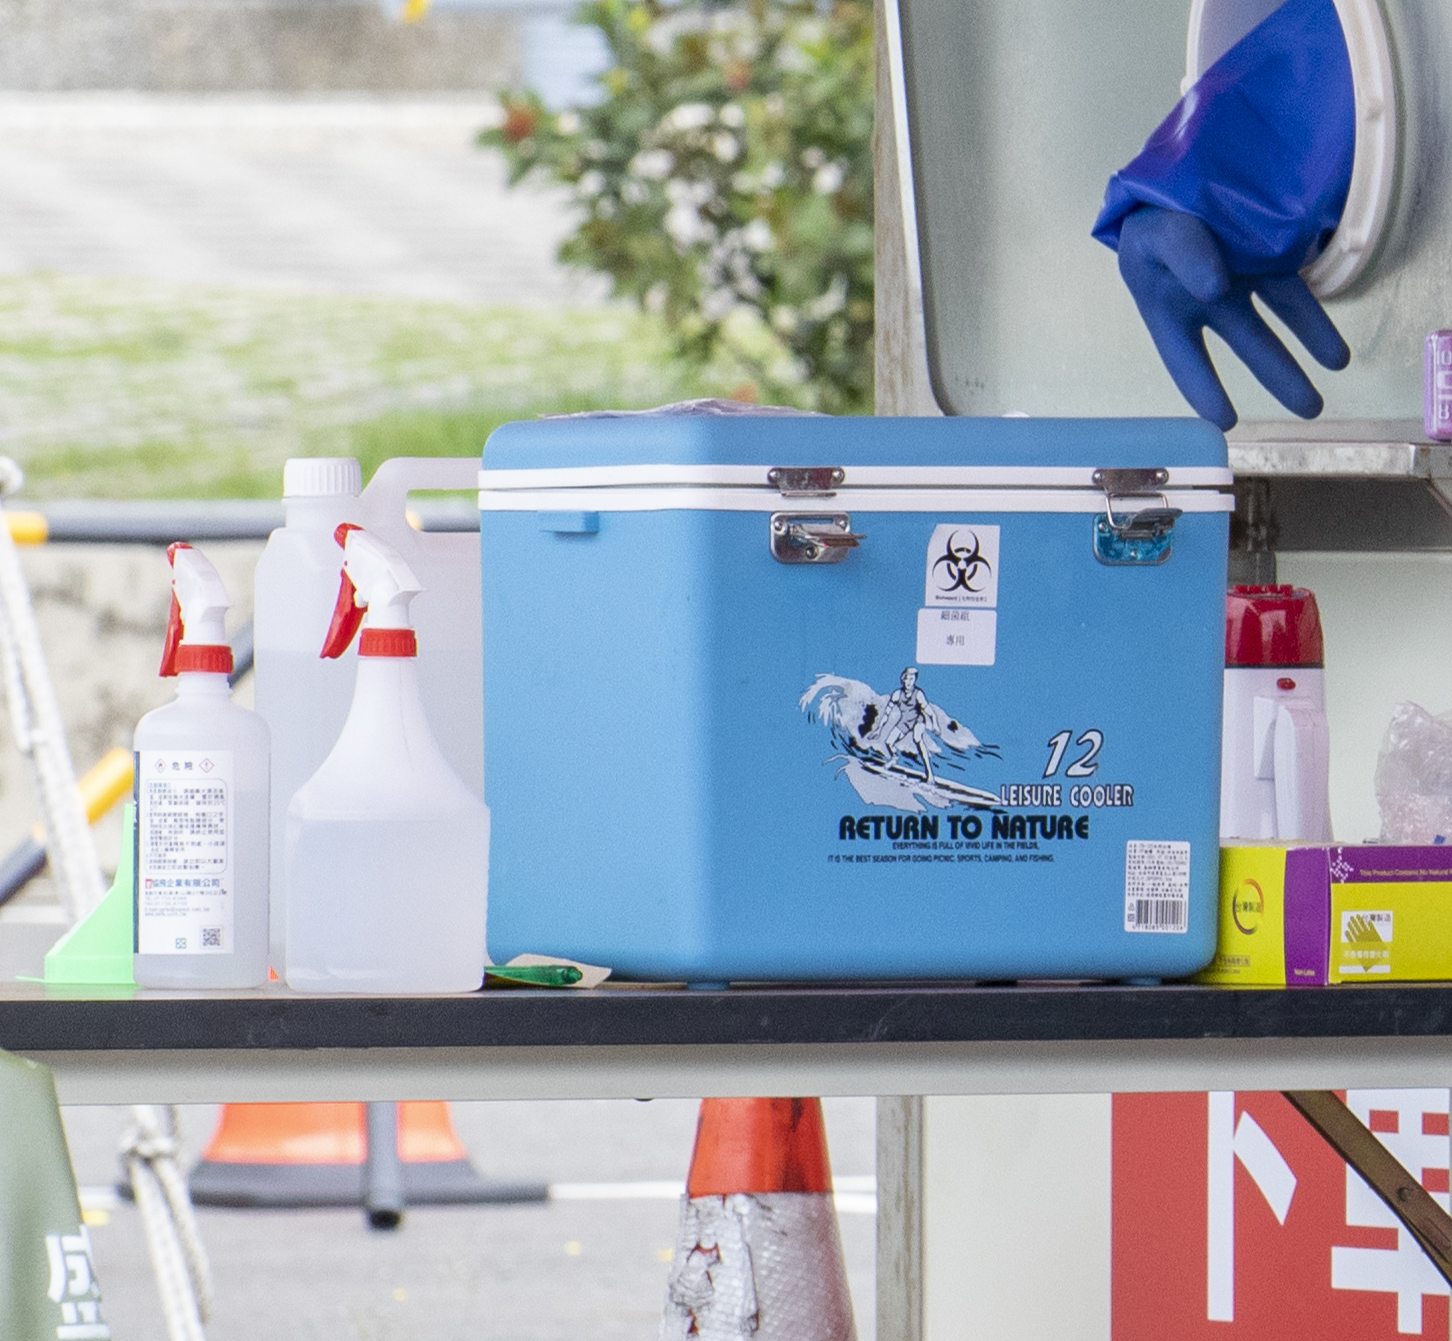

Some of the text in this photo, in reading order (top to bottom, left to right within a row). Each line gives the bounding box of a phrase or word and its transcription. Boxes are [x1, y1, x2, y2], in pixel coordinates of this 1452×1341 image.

[1042, 728, 1104, 779] 12
[1000, 783, 1134, 808] LEISURE COOLER
[839, 814, 1089, 840] RETURN TO NATURE
[892, 842, 931, 851] EVERYTHING
[932, 842, 938, 851] IS
[939, 842, 954, 851] FULL
[955, 842, 964, 851] OF
[982, 842, 994, 851] LIFE
[996, 842, 1002, 851] IN
[1004, 842, 1015, 851] THE
[855, 854, 872, 864] BEST
[872, 854, 897, 864] SEASON
[898, 854, 911, 864] FOR
[1372, 869, 1394, 877] Product
